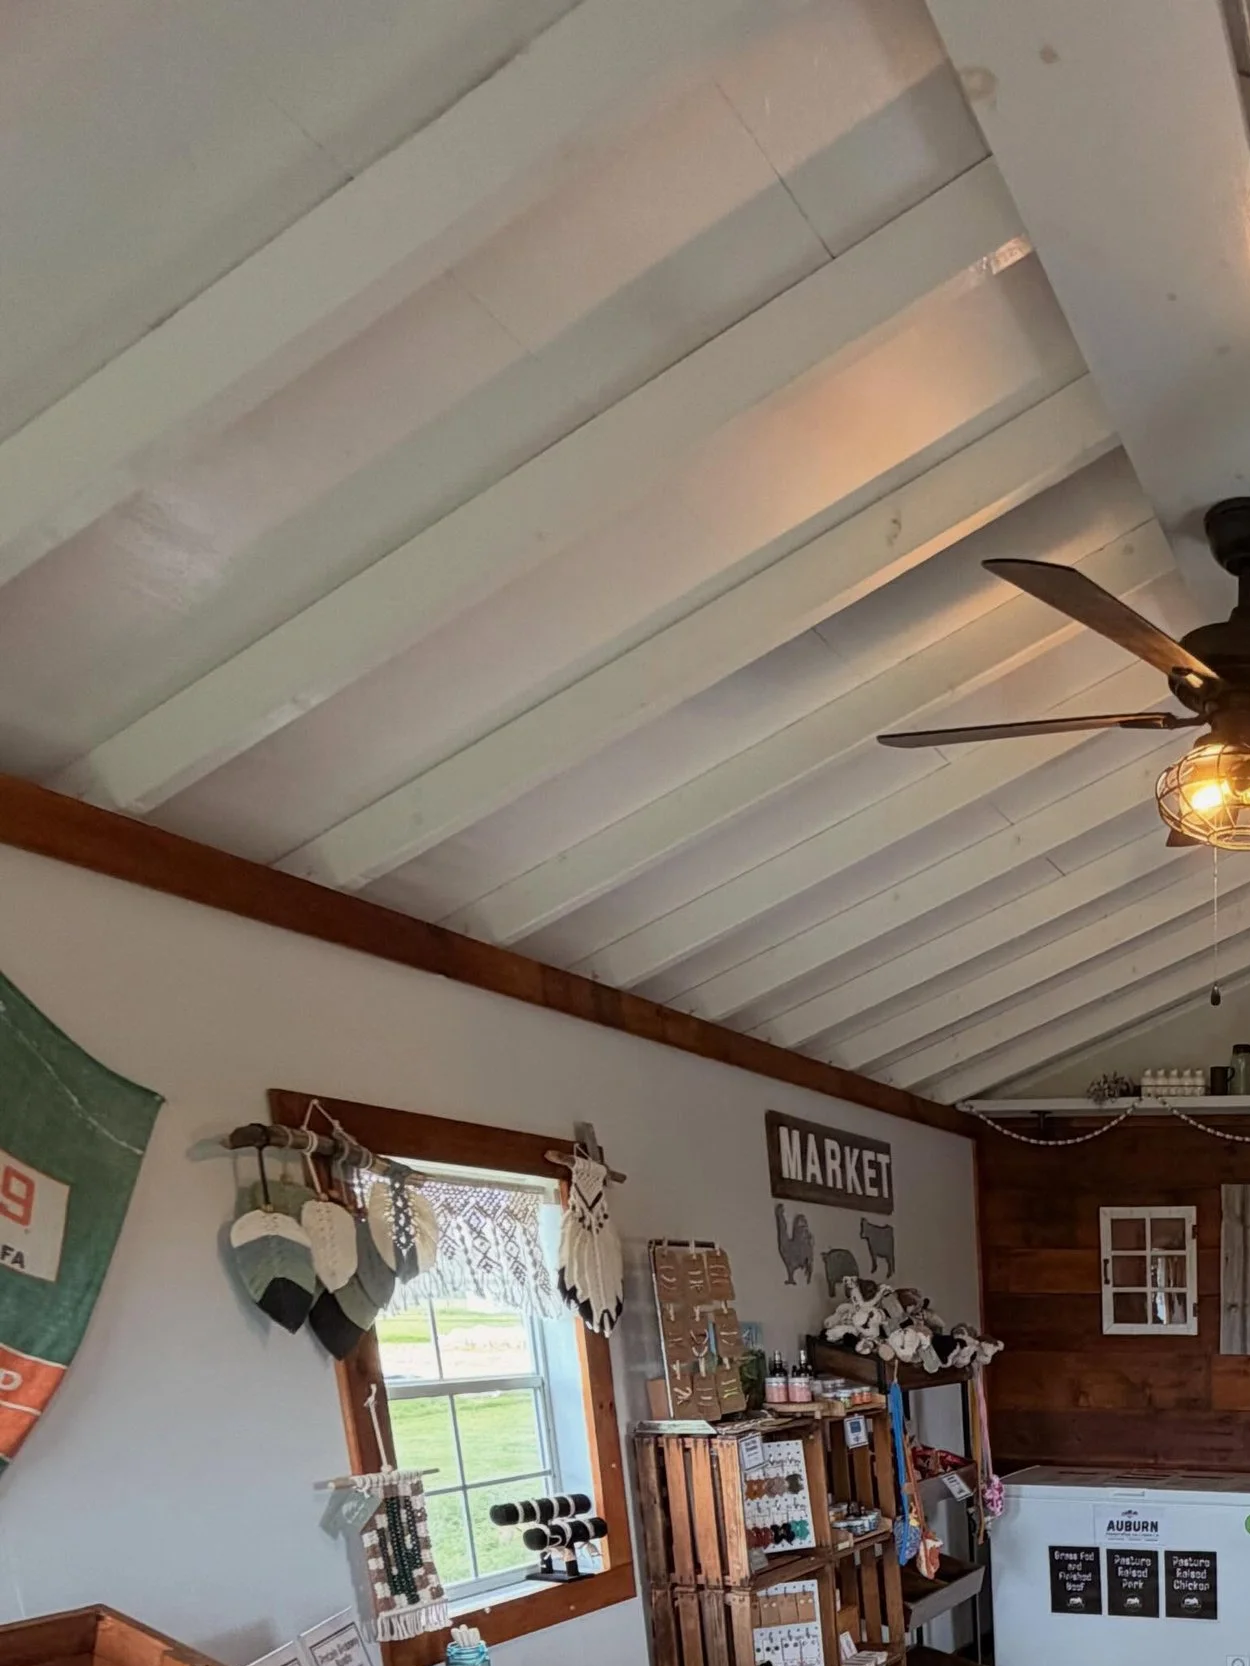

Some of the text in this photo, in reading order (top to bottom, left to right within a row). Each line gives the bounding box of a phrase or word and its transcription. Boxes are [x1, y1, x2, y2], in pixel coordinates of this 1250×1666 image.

[778, 1125, 891, 1199] MARKET
[1107, 1520, 1158, 1532] AUBURN
[1114, 1555, 1152, 1567] Pasture
[1172, 1556, 1210, 1568] Pasture
[1117, 1567, 1149, 1578] Raised
[1176, 1568, 1207, 1579] Raised
[1173, 1580, 1210, 1592] Chicken
